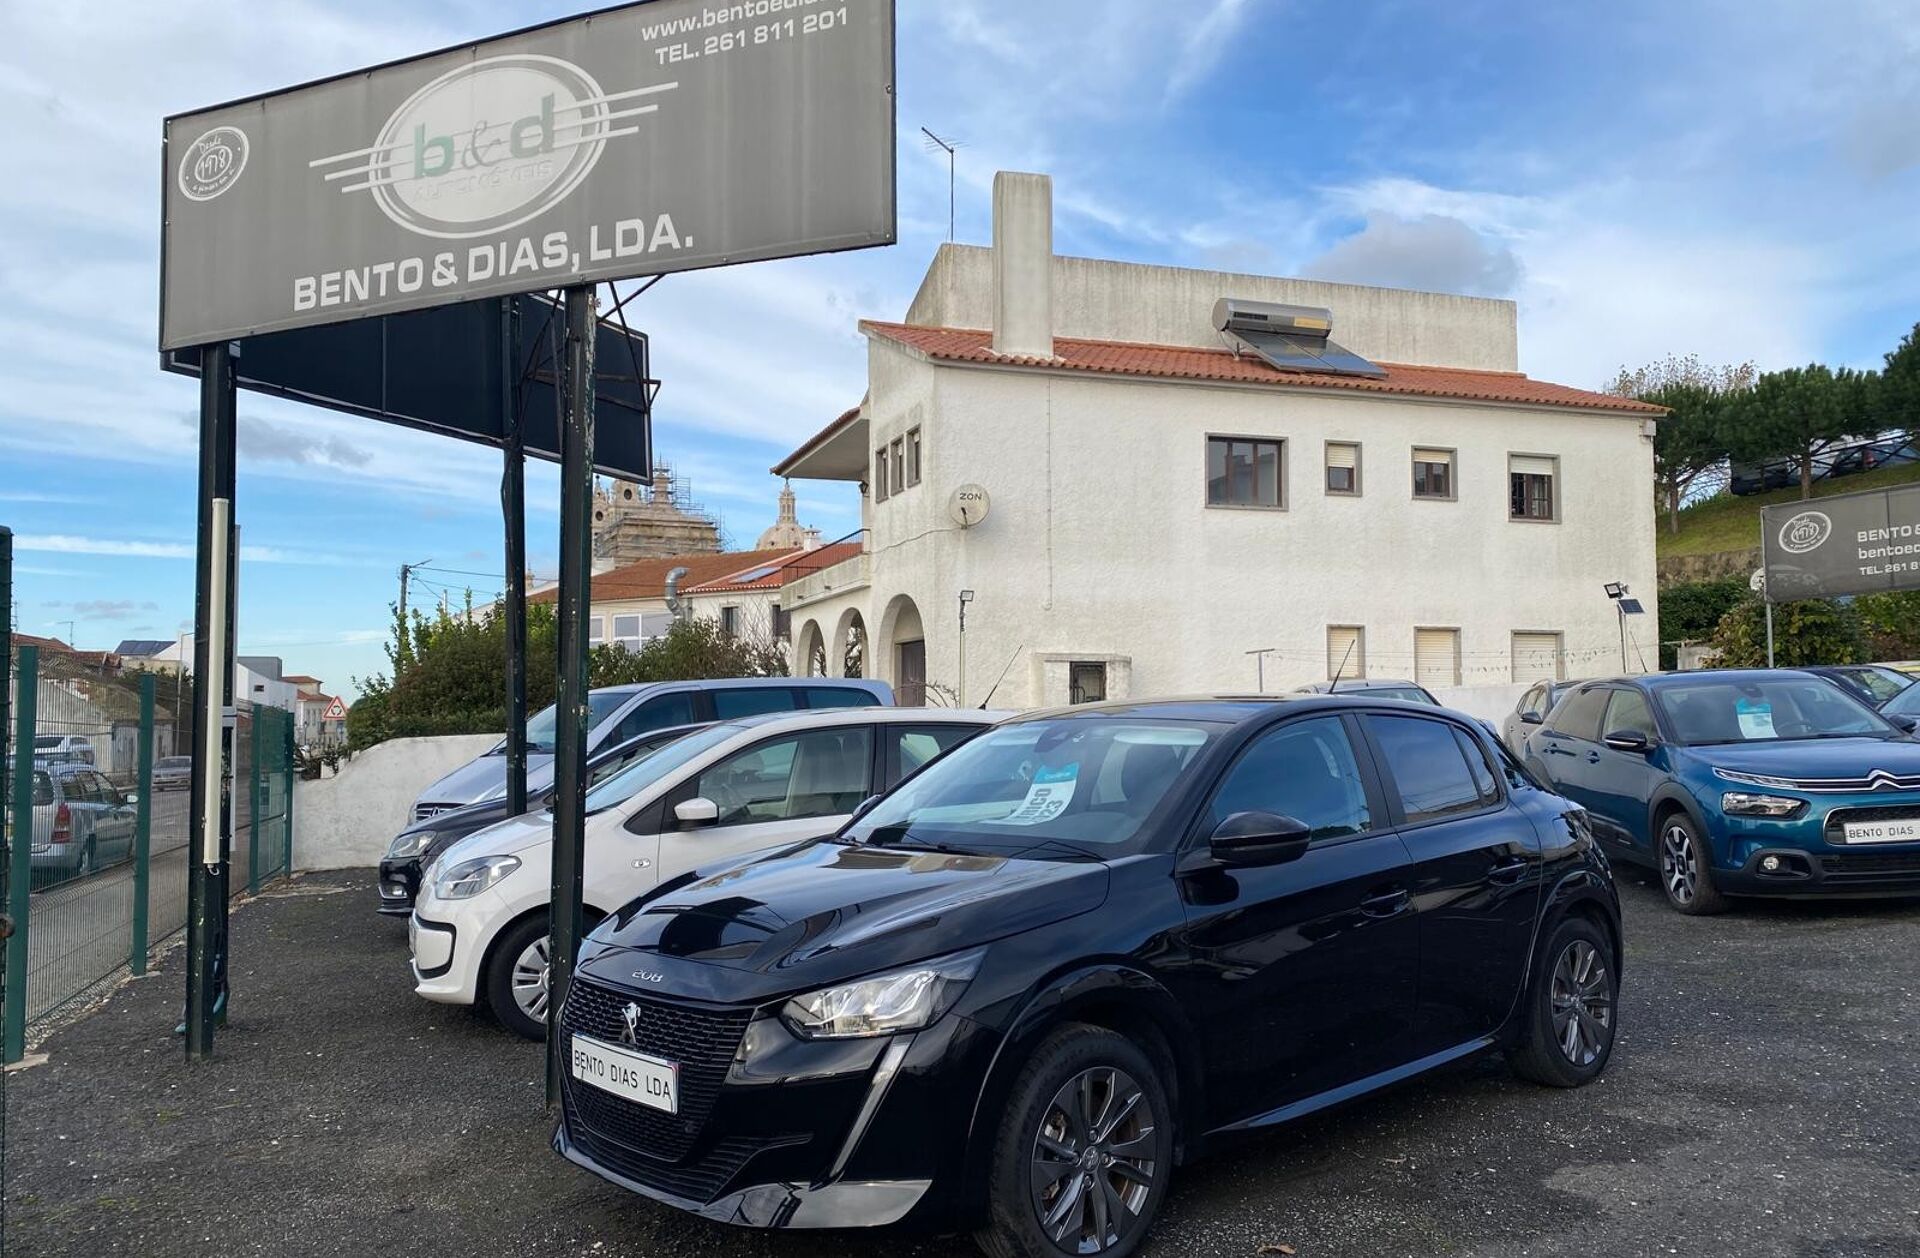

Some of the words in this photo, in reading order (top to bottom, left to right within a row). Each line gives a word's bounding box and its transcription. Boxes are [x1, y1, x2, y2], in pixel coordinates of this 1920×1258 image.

[655, 43, 700, 65] TEL.
[704, 30, 746, 55] 261
[754, 18, 794, 44] 811
[803, 6, 847, 34] 201
[293, 257, 424, 312] BENTO
[431, 252, 459, 287] &
[467, 231, 580, 283] DIAS,
[590, 213, 694, 262] LDA.
[959, 492, 982, 501] ZON
[1857, 525, 1912, 542] BENTO
[1884, 562, 1907, 574] 261
[1848, 828, 1883, 839] BENTO
[1888, 826, 1914, 836] DIAS
[631, 969, 664, 983] 208
[574, 1050, 605, 1078] BENTO
[610, 1065, 639, 1089] DIAS
[646, 1075, 673, 1099] LDA
